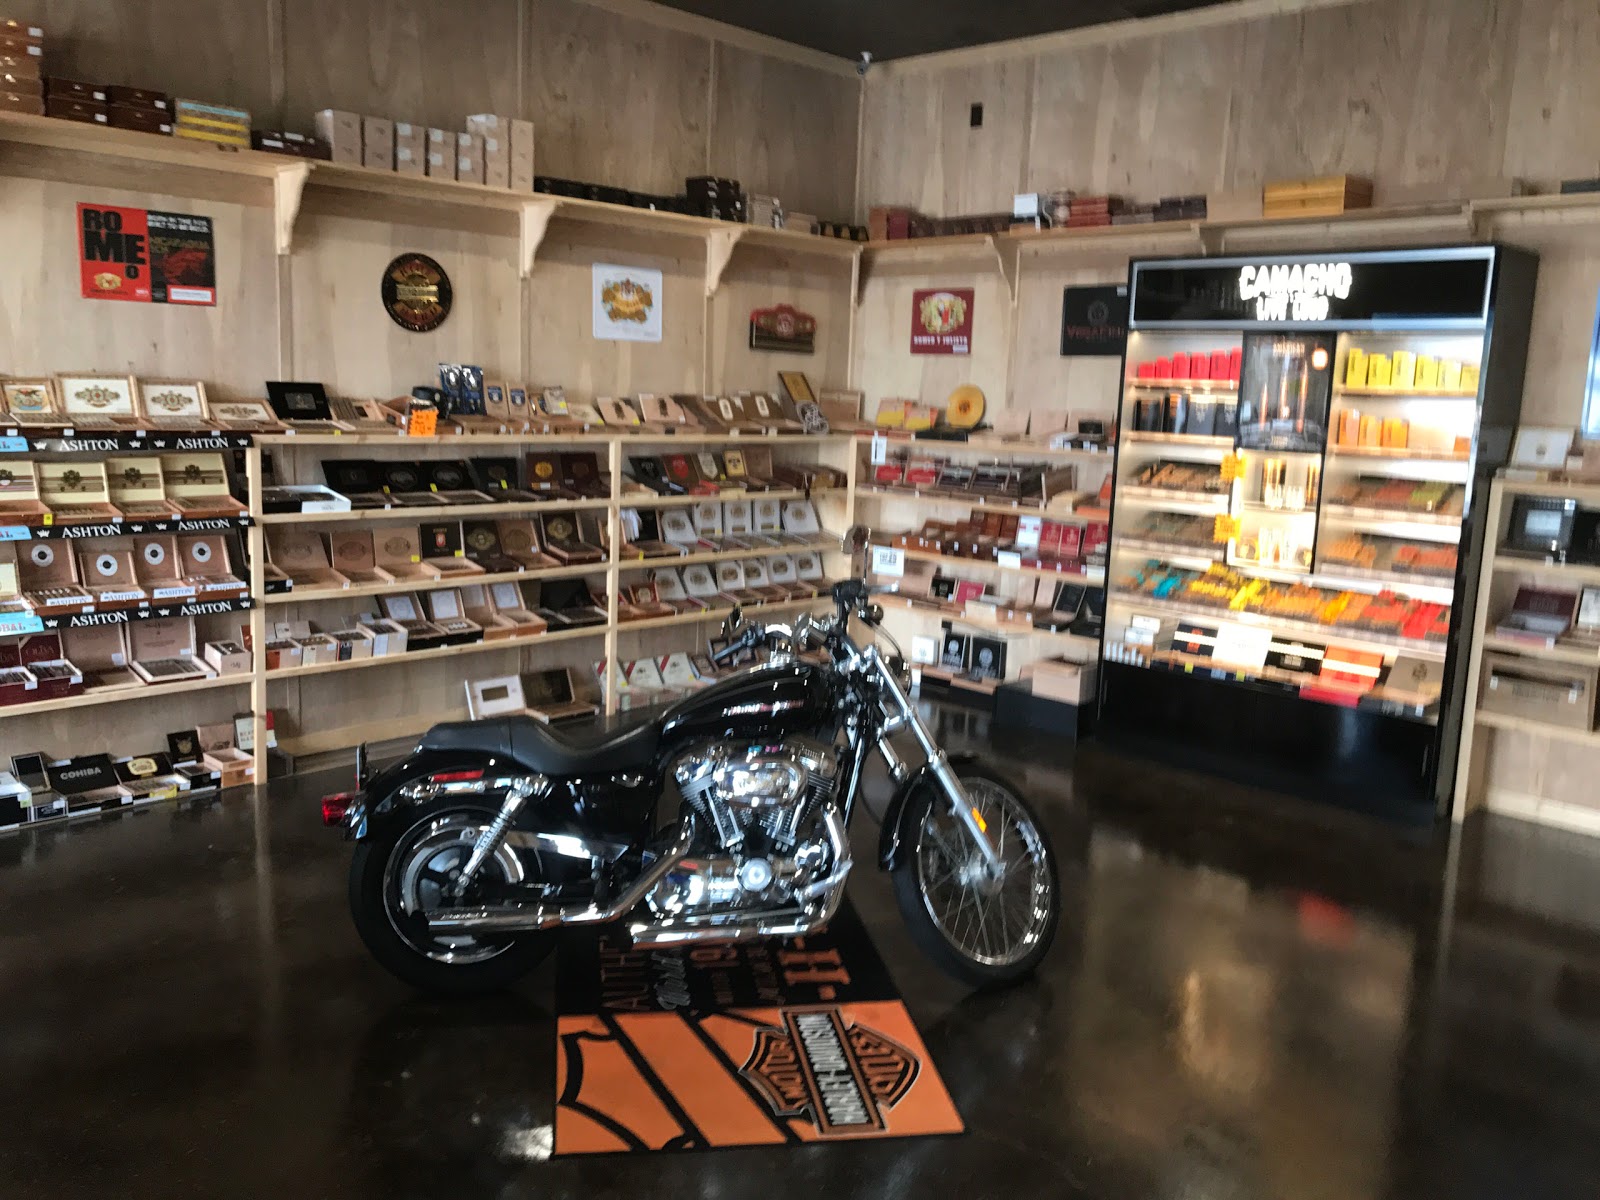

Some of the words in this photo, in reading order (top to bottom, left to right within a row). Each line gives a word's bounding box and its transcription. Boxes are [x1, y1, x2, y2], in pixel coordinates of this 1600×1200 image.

[1239, 262, 1352, 300] CAMACHO
[60, 439, 118, 451] ASHTON
[176, 437, 229, 449] ASHTON
[62, 523, 122, 538] ASHTON
[178, 518, 231, 531] ASHTON
[180, 600, 233, 616] ASHTON
[70, 611, 129, 628] ASHTON
[60, 767, 101, 780] COHIBA
[797, 1013, 869, 1126] HARLEY-DAVIDSON
